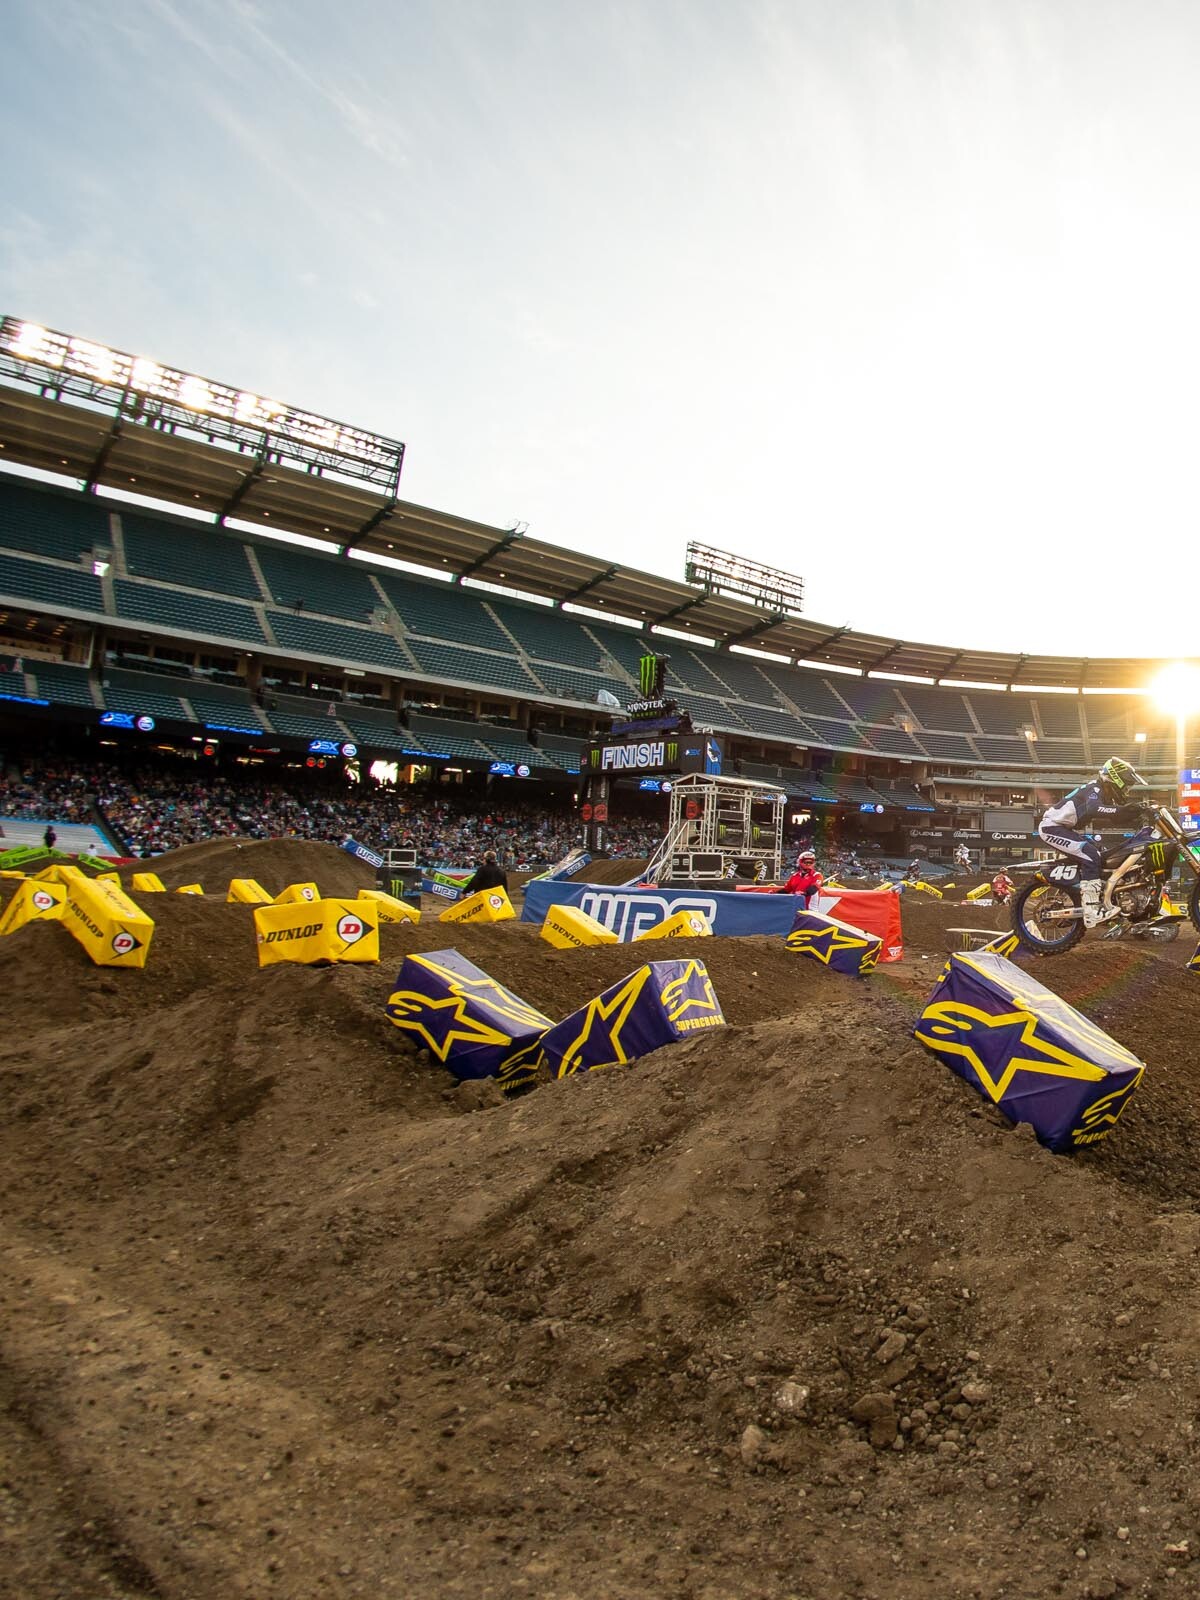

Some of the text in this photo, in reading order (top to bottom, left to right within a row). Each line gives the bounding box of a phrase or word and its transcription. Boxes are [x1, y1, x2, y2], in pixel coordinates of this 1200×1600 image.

[627, 700, 665, 712] MONSTER
[602, 742, 665, 770] FINISH
[1045, 835, 1071, 848] THOR
[355, 847, 384, 868] WPS
[1050, 865, 1077, 881] 45
[432, 883, 458, 900] WPS
[71, 903, 104, 938] DUNLOP
[377, 910, 395, 923] LOP
[265, 923, 323, 943] DUNLOP
[675, 1013, 725, 1031] SUPERCROSS
